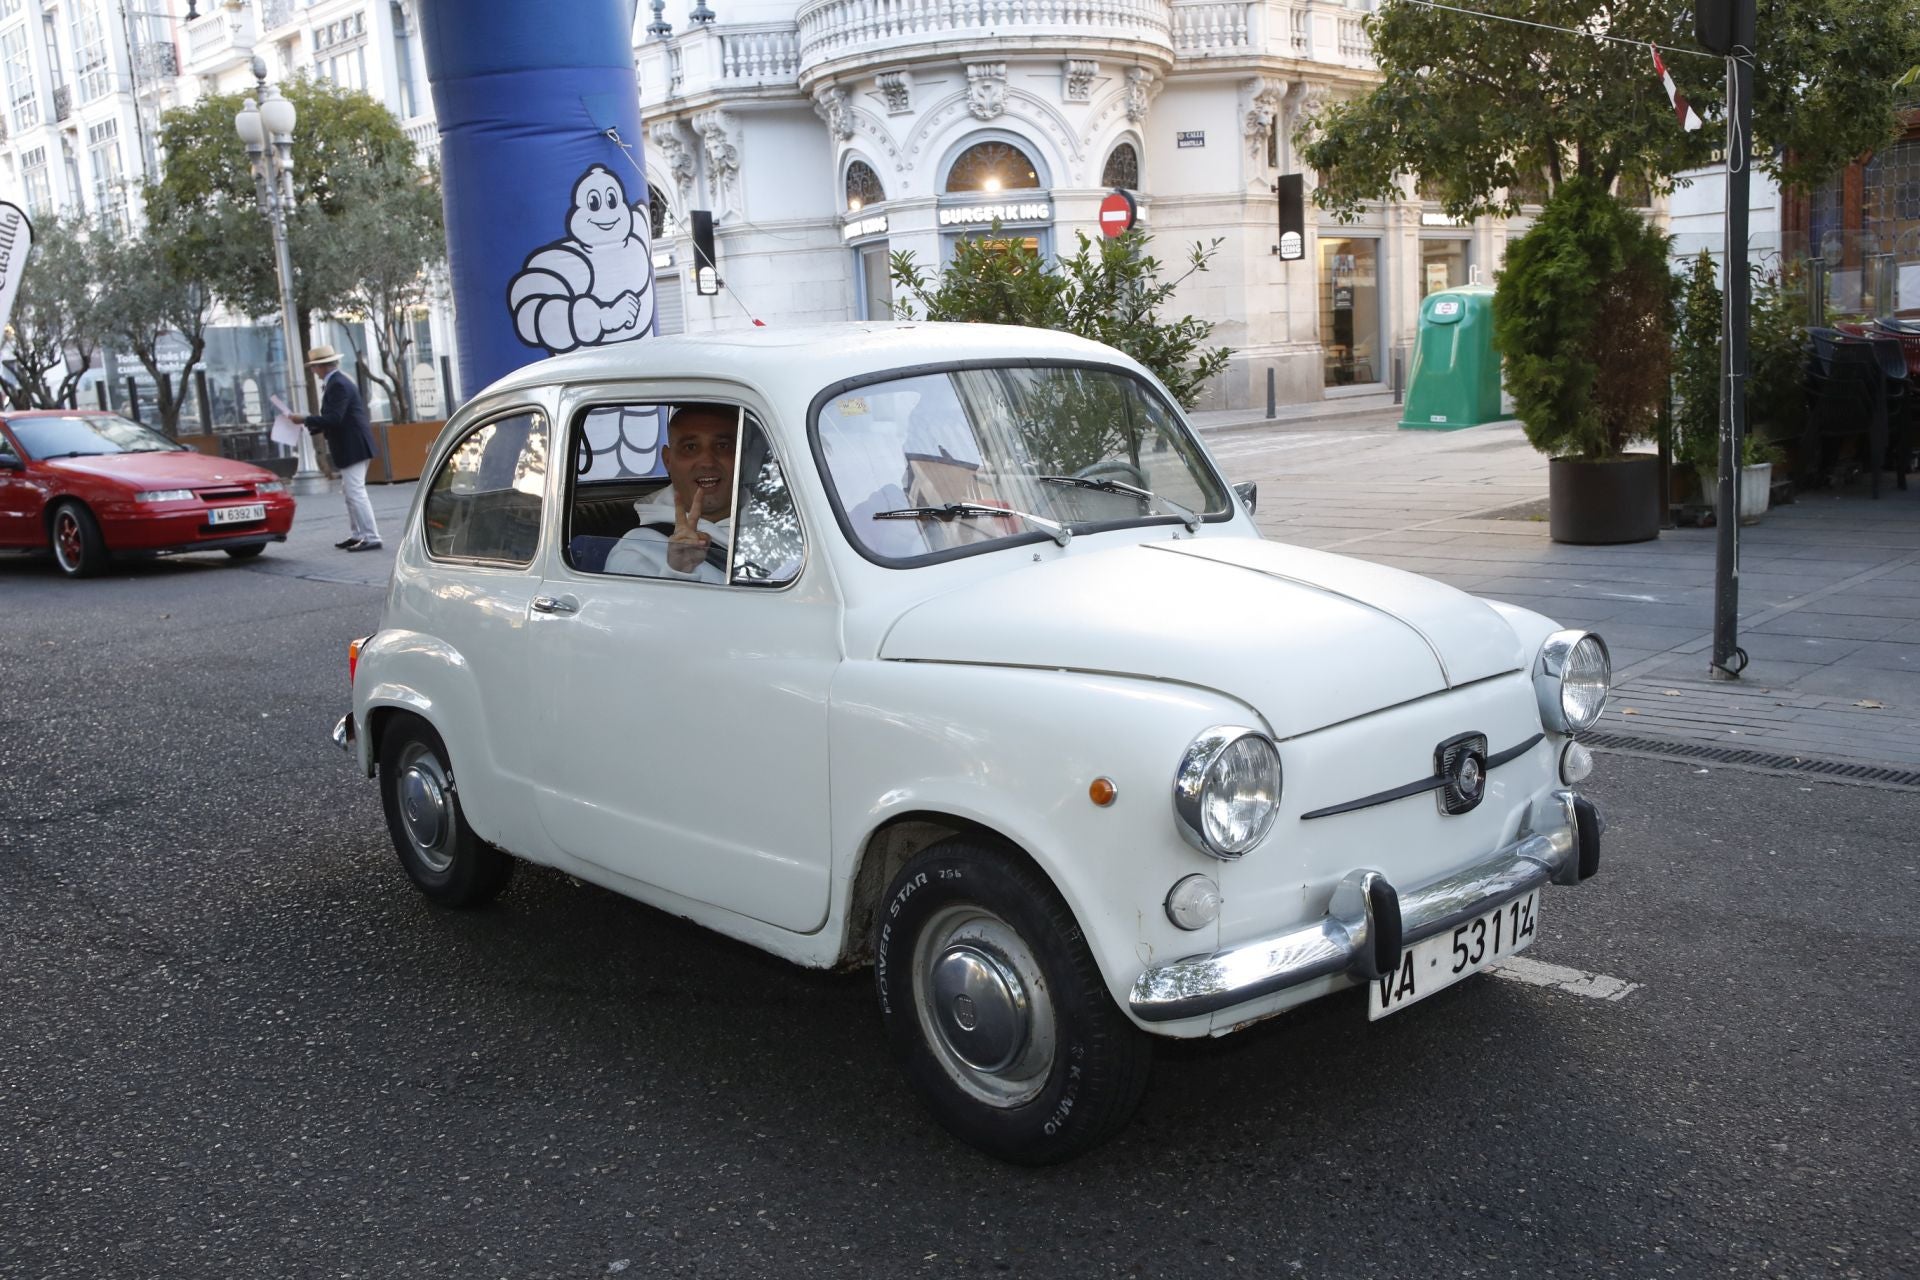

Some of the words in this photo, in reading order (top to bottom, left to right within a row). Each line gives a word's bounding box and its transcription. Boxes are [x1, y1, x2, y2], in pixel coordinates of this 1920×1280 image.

[939, 206, 1005, 225] BURGER
[1006, 204, 1050, 220] KING
[227, 507, 251, 520] 6392
[890, 872, 928, 918] STAR
[1379, 950, 1415, 1009] VA
[1452, 894, 1534, 974] 53114
